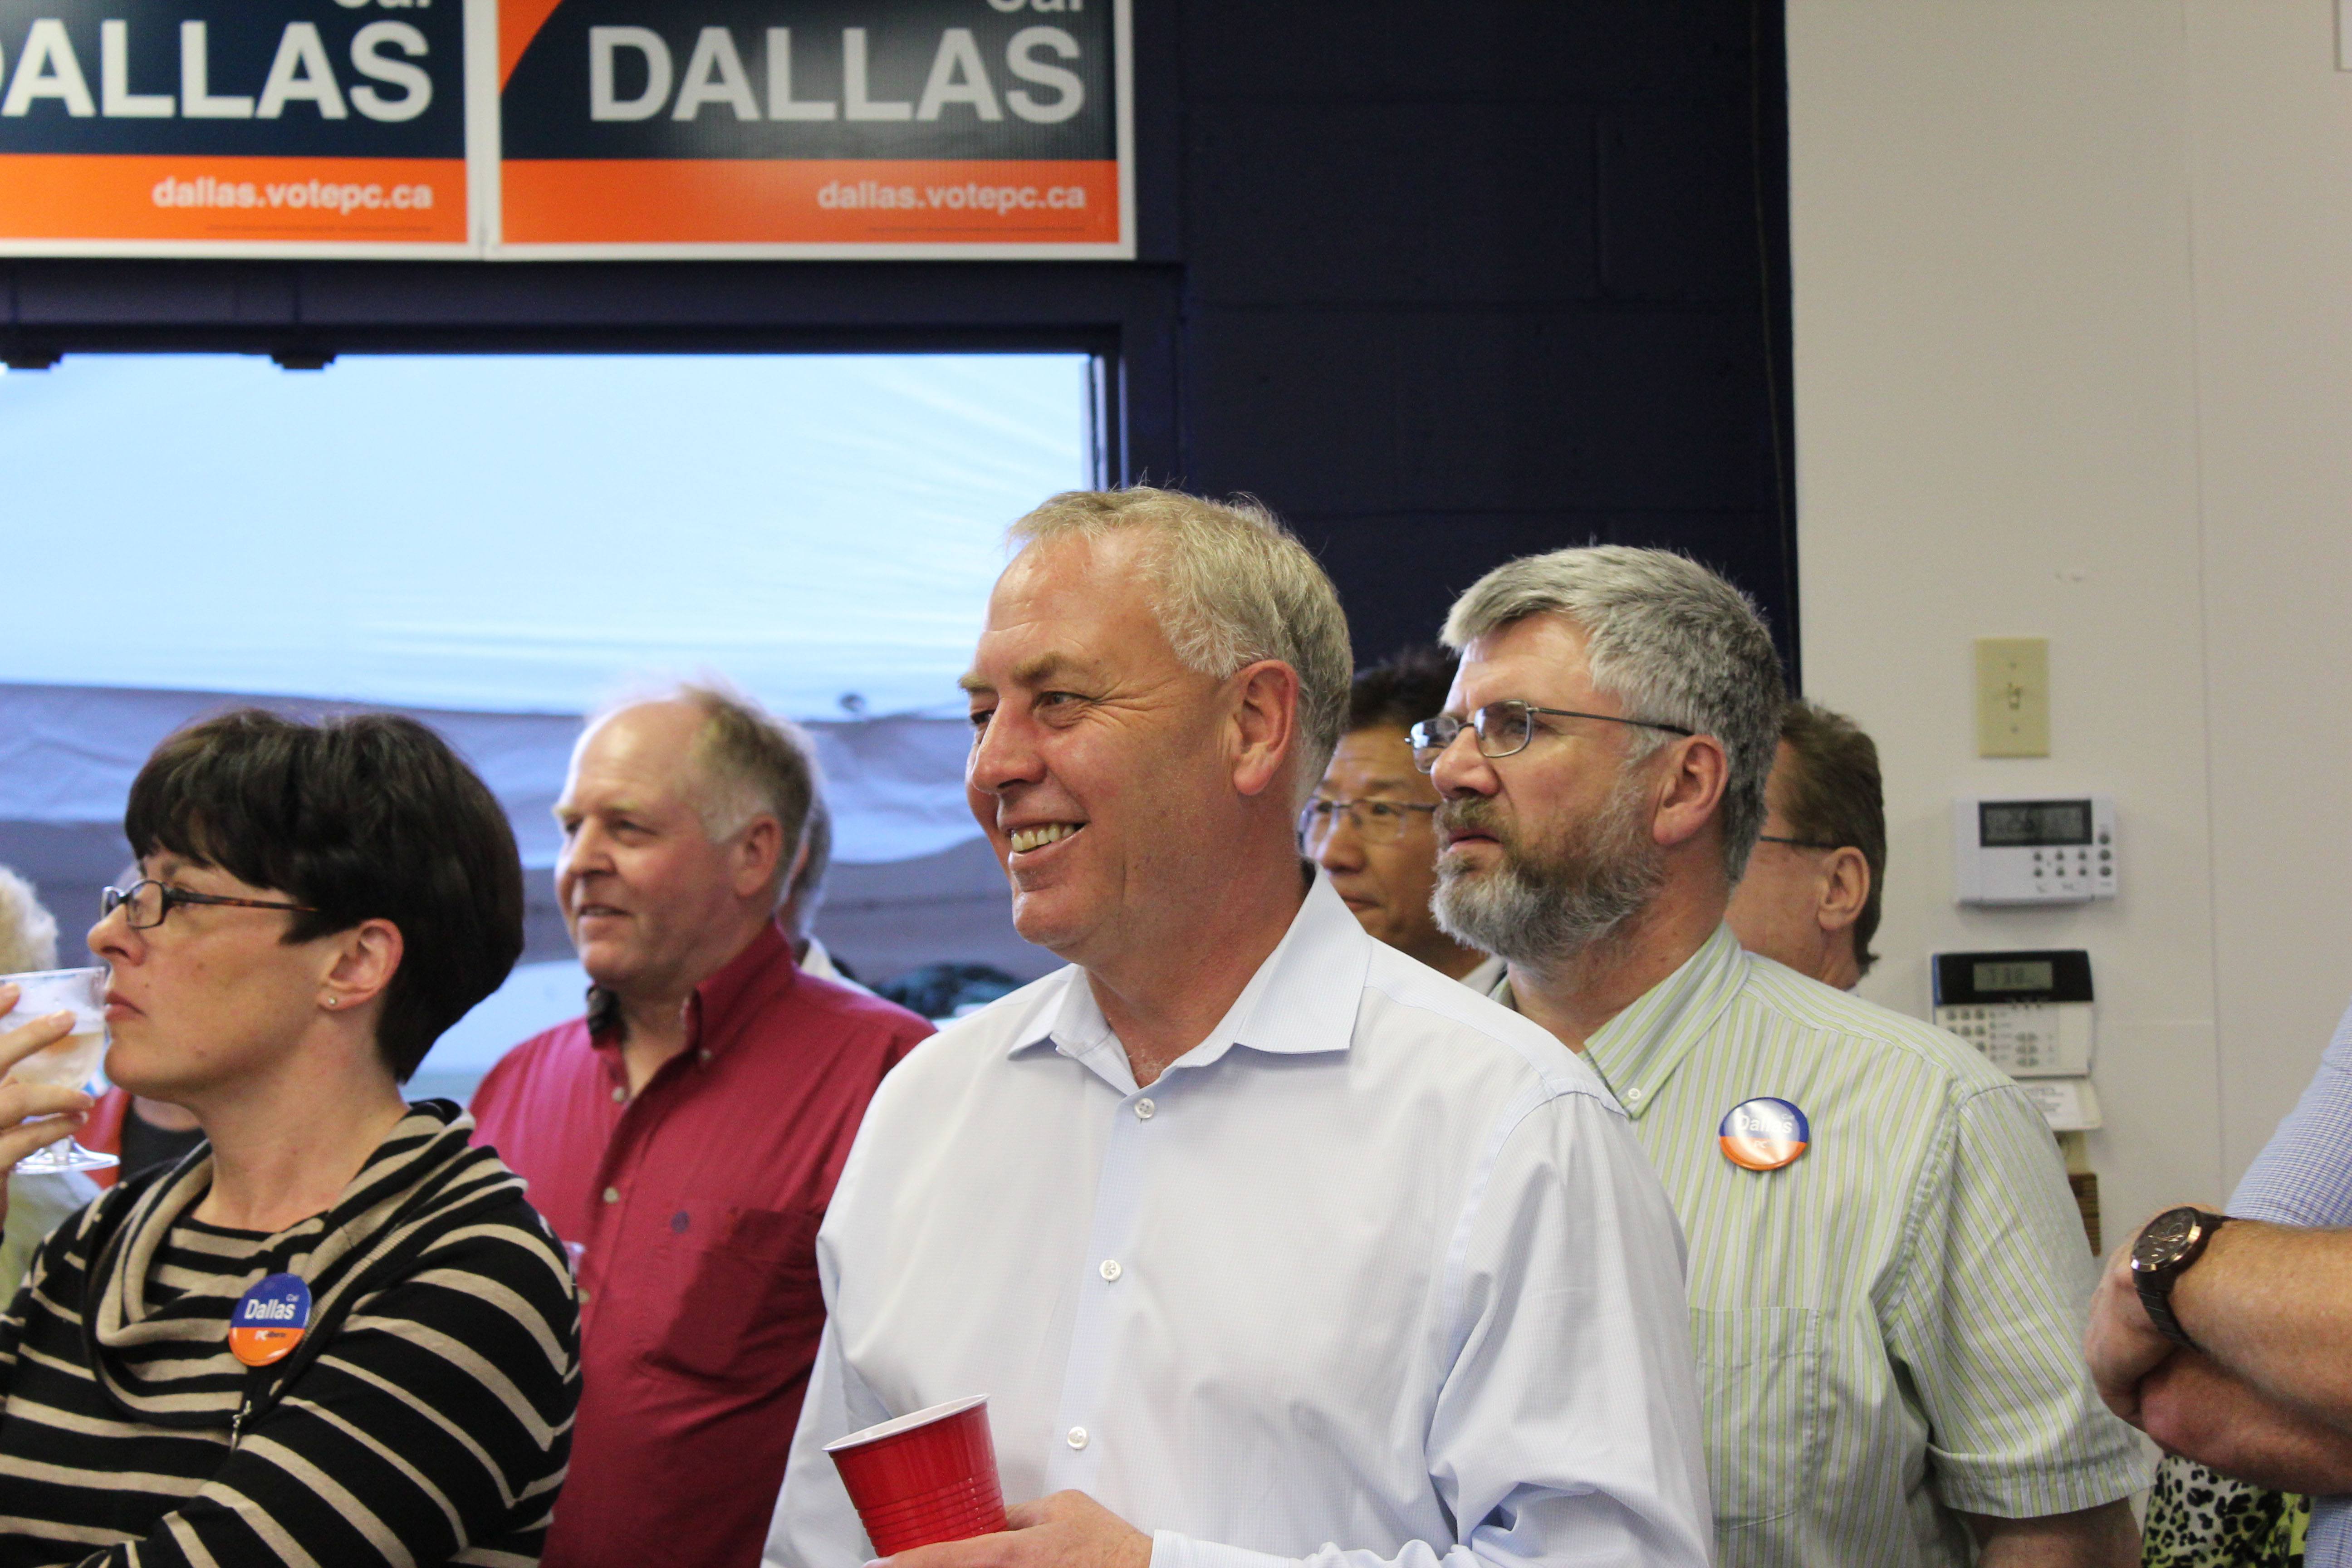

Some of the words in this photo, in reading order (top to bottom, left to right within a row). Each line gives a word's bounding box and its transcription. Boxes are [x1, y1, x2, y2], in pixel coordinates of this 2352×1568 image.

[0, 19, 433, 122] ALLAS
[589, 25, 1085, 123] DALLAS
[152, 176, 433, 216] dallas.votepc.ca
[817, 181, 1086, 216] dallas.votepc.ca
[244, 1298, 296, 1319] Dallas
